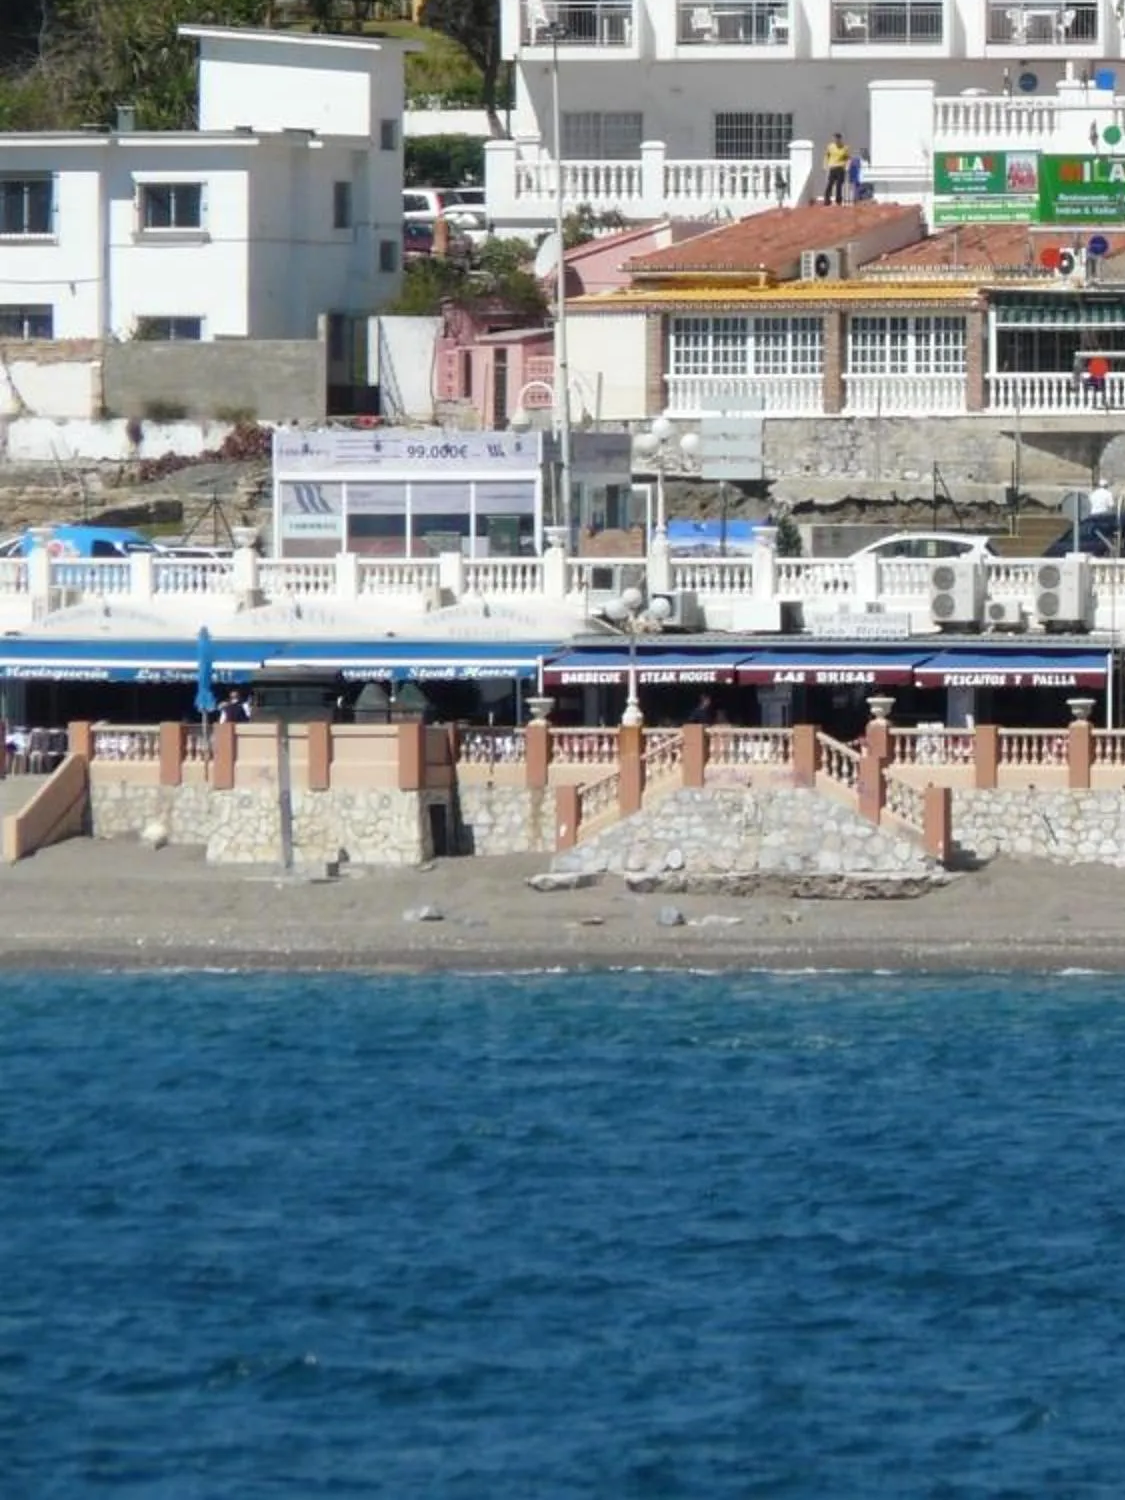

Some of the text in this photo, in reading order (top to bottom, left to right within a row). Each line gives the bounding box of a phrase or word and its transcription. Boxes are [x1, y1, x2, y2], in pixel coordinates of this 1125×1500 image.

[407, 443, 468, 459] 99.000€
[639, 671, 676, 683] STEAK
[679, 671, 717, 683] HOUSE
[773, 671, 876, 684] LAS BRISAS
[1032, 674, 1077, 687] PAELLA
